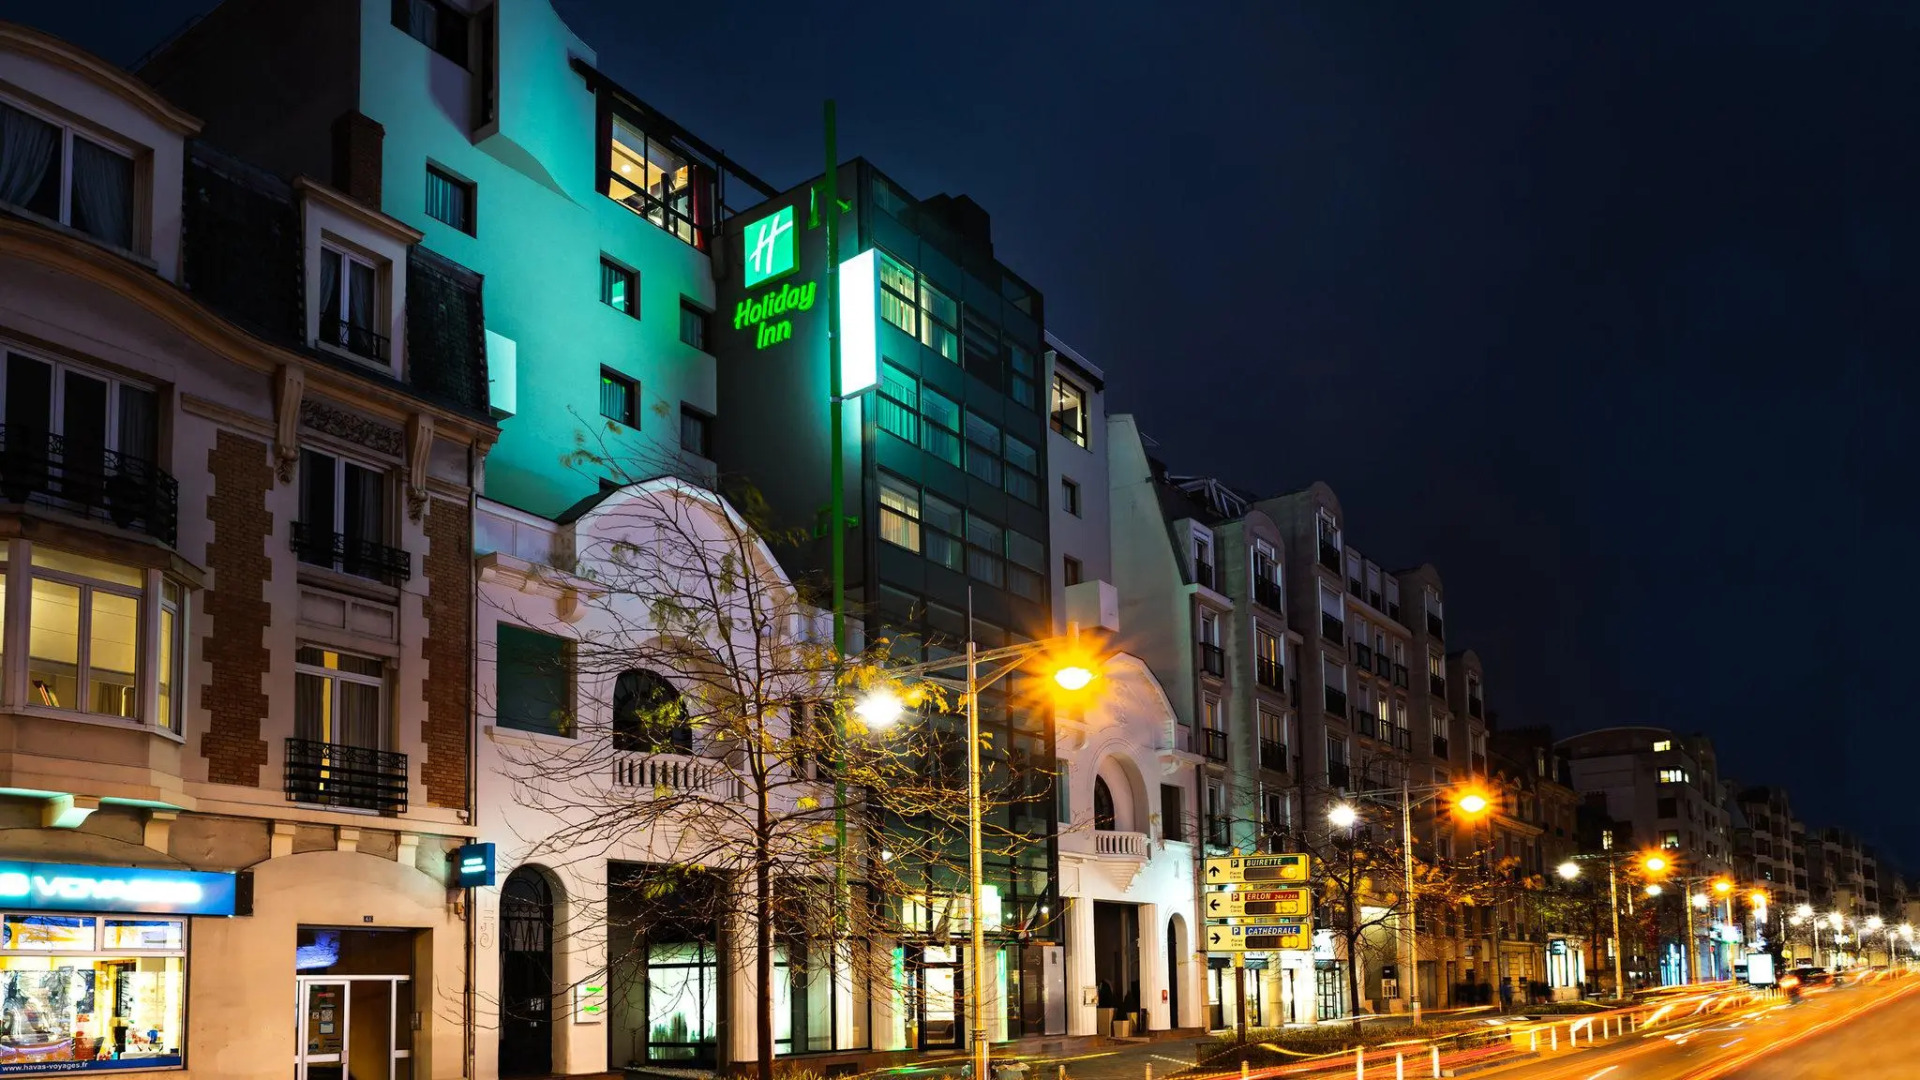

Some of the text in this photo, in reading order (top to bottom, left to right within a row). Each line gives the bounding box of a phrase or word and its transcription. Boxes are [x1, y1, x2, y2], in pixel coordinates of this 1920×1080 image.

[734, 281, 817, 330] Holiday
[756, 318, 792, 350] Inn
[1246, 858, 1282, 867] BUIRETTE
[1247, 926, 1296, 935] CATHÉDRALE
[2, 1061, 89, 1072] www.havas-voyages.fr
